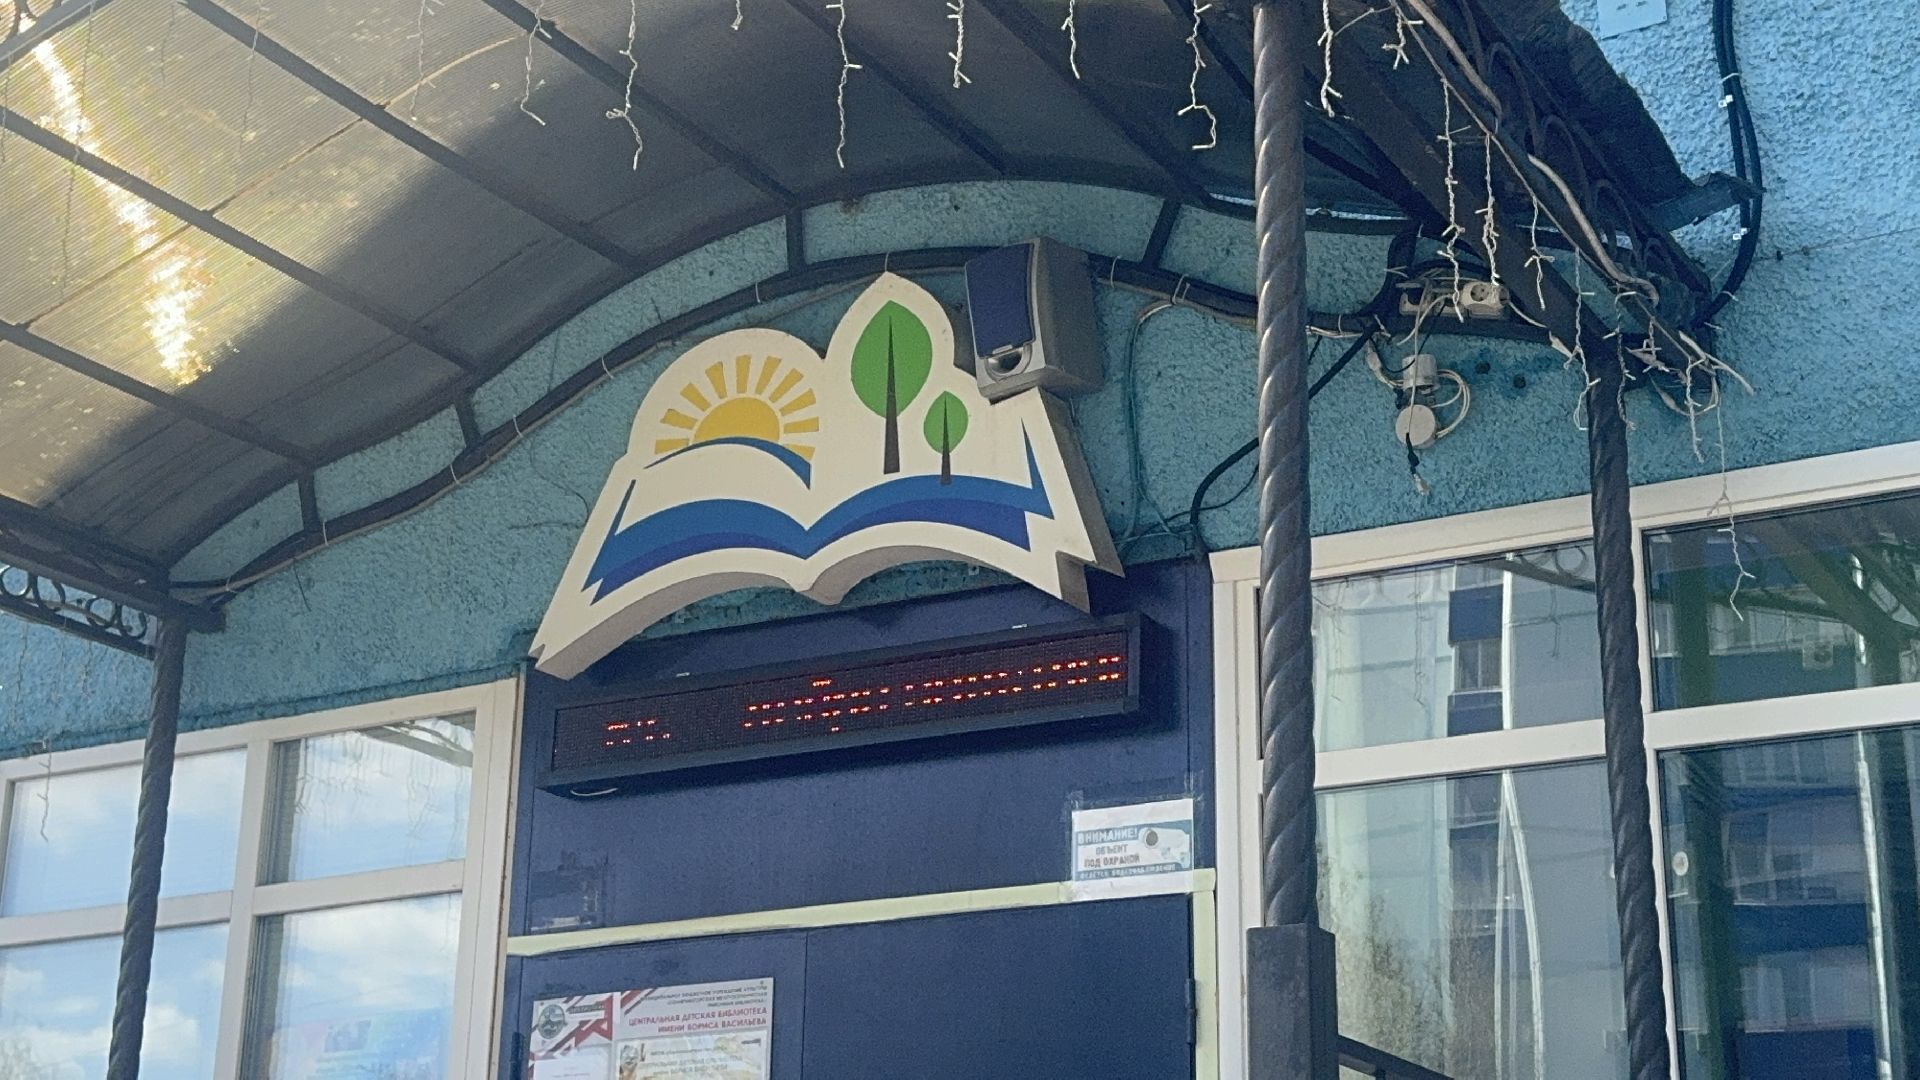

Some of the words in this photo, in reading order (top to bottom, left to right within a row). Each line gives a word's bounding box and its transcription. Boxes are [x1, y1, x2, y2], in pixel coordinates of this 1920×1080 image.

[1078, 828, 1138, 843] ВНИМАНИЕ!
[1096, 844, 1128, 855] ОБЪЕКТ
[1084, 858, 1101, 868] ПОД
[1103, 854, 1140, 866] ОХРАНОЙ
[629, 1014, 680, 1026] ЦЕНТРАЛЬНАЯ
[682, 1011, 716, 1022] ДЕТСКАЯ
[718, 1007, 768, 1018] БИБЛИОТЕКА
[658, 1023, 685, 1033] ИМЕНИ
[687, 1021, 719, 1031] БОРИСА
[722, 1018, 767, 1028] ВАСИЛЬЕВА
